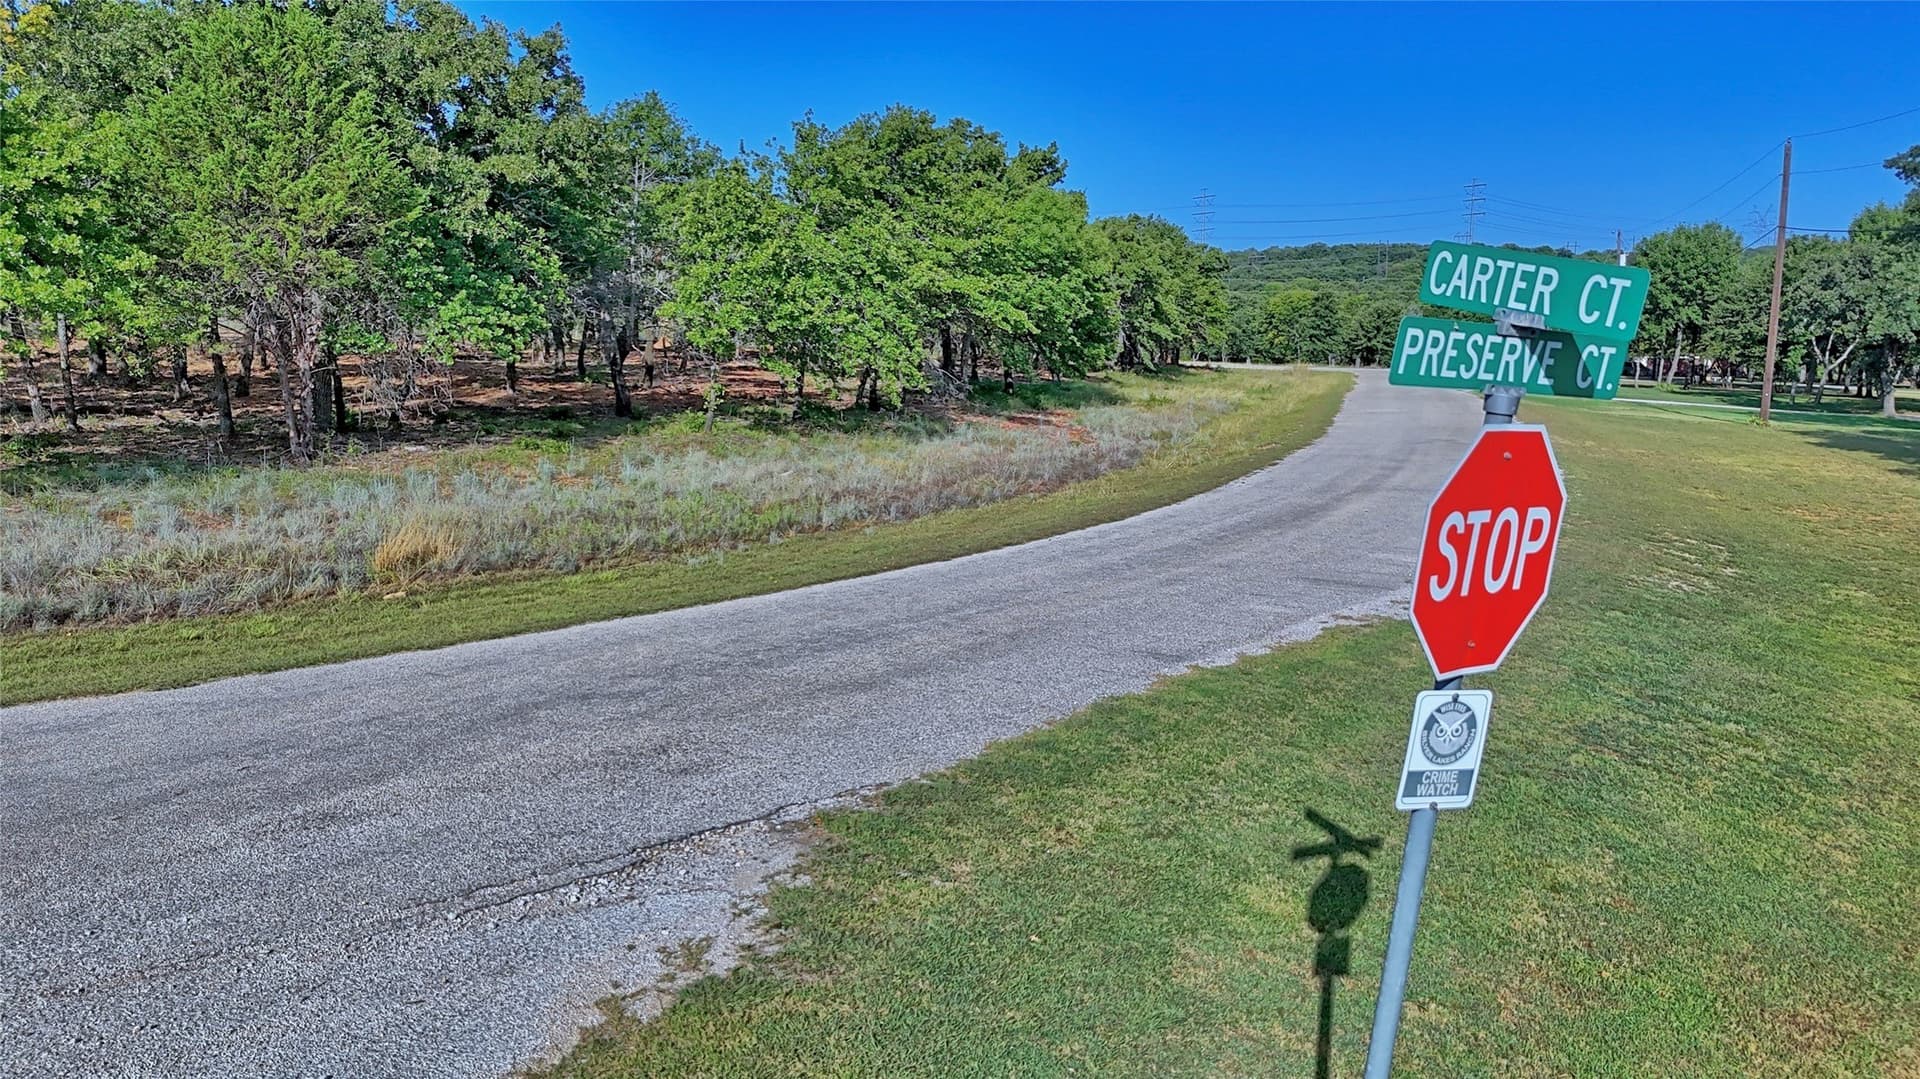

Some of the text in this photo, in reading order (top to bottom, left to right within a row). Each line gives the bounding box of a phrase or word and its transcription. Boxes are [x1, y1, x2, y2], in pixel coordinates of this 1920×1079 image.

[1430, 251, 1632, 330] CARTER CT.
[1398, 328, 1617, 391] PRESERVE CT.
[1429, 507, 1552, 602] STOP
[1432, 755, 1456, 764] LAKES
[1456, 729, 1476, 761] RANCH
[1416, 783, 1458, 796] WATCH
[1422, 770, 1458, 784] CRIME
